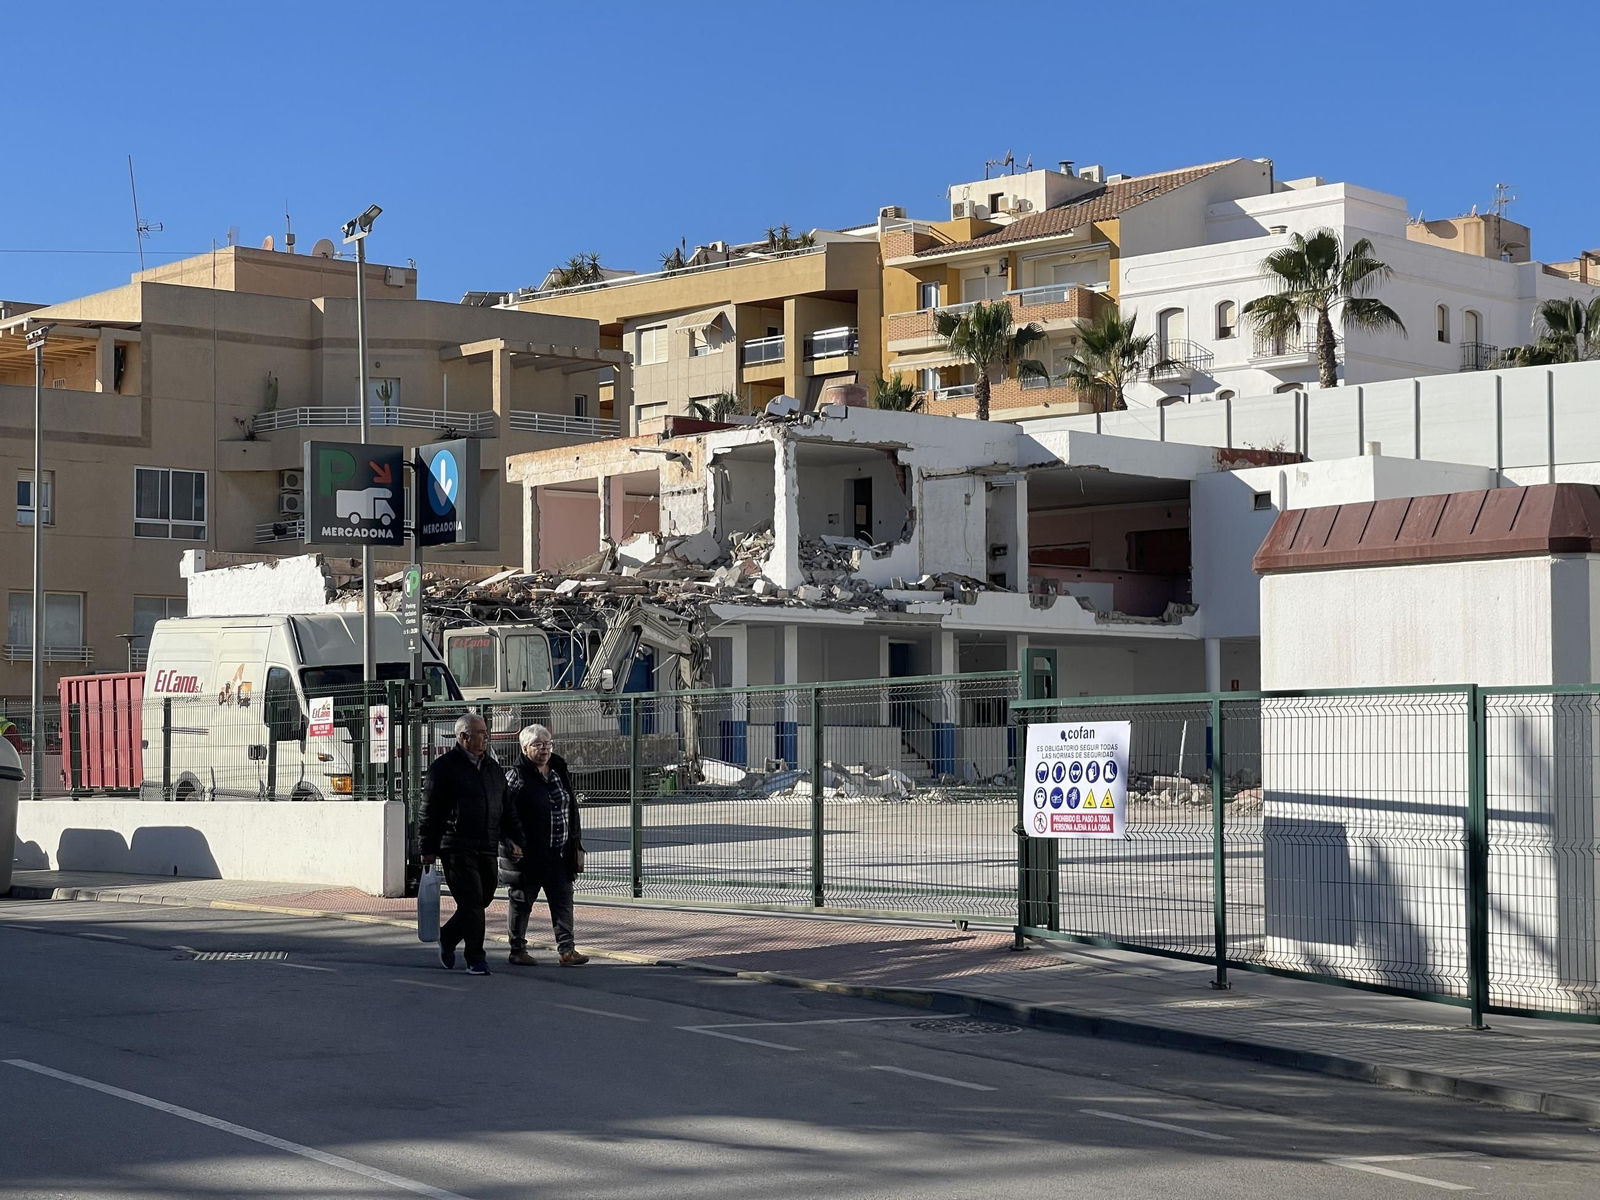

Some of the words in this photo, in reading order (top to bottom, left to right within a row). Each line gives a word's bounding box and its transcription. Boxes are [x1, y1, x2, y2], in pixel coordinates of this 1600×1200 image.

[319, 448, 356, 495] P
[321, 526, 394, 539] MERCADONA
[422, 520, 463, 535] MERCADONA
[1067, 726, 1095, 739] cofan
[1044, 744, 1079, 752] OBLIGATORIO
[1079, 743, 1099, 751] SEGUIR
[1053, 814, 1076, 822] PROHIBIDO
[1076, 814, 1082, 822] EL
[1082, 814, 1093, 823] PASO
[1093, 815, 1098, 823] A
[1098, 815, 1111, 823] TODA
[1053, 823, 1073, 831] PERSONA
[1073, 823, 1087, 831] AJENA
[1087, 823, 1091, 831] A
[1091, 823, 1098, 831] LA
[1098, 823, 1111, 832] OBRA
